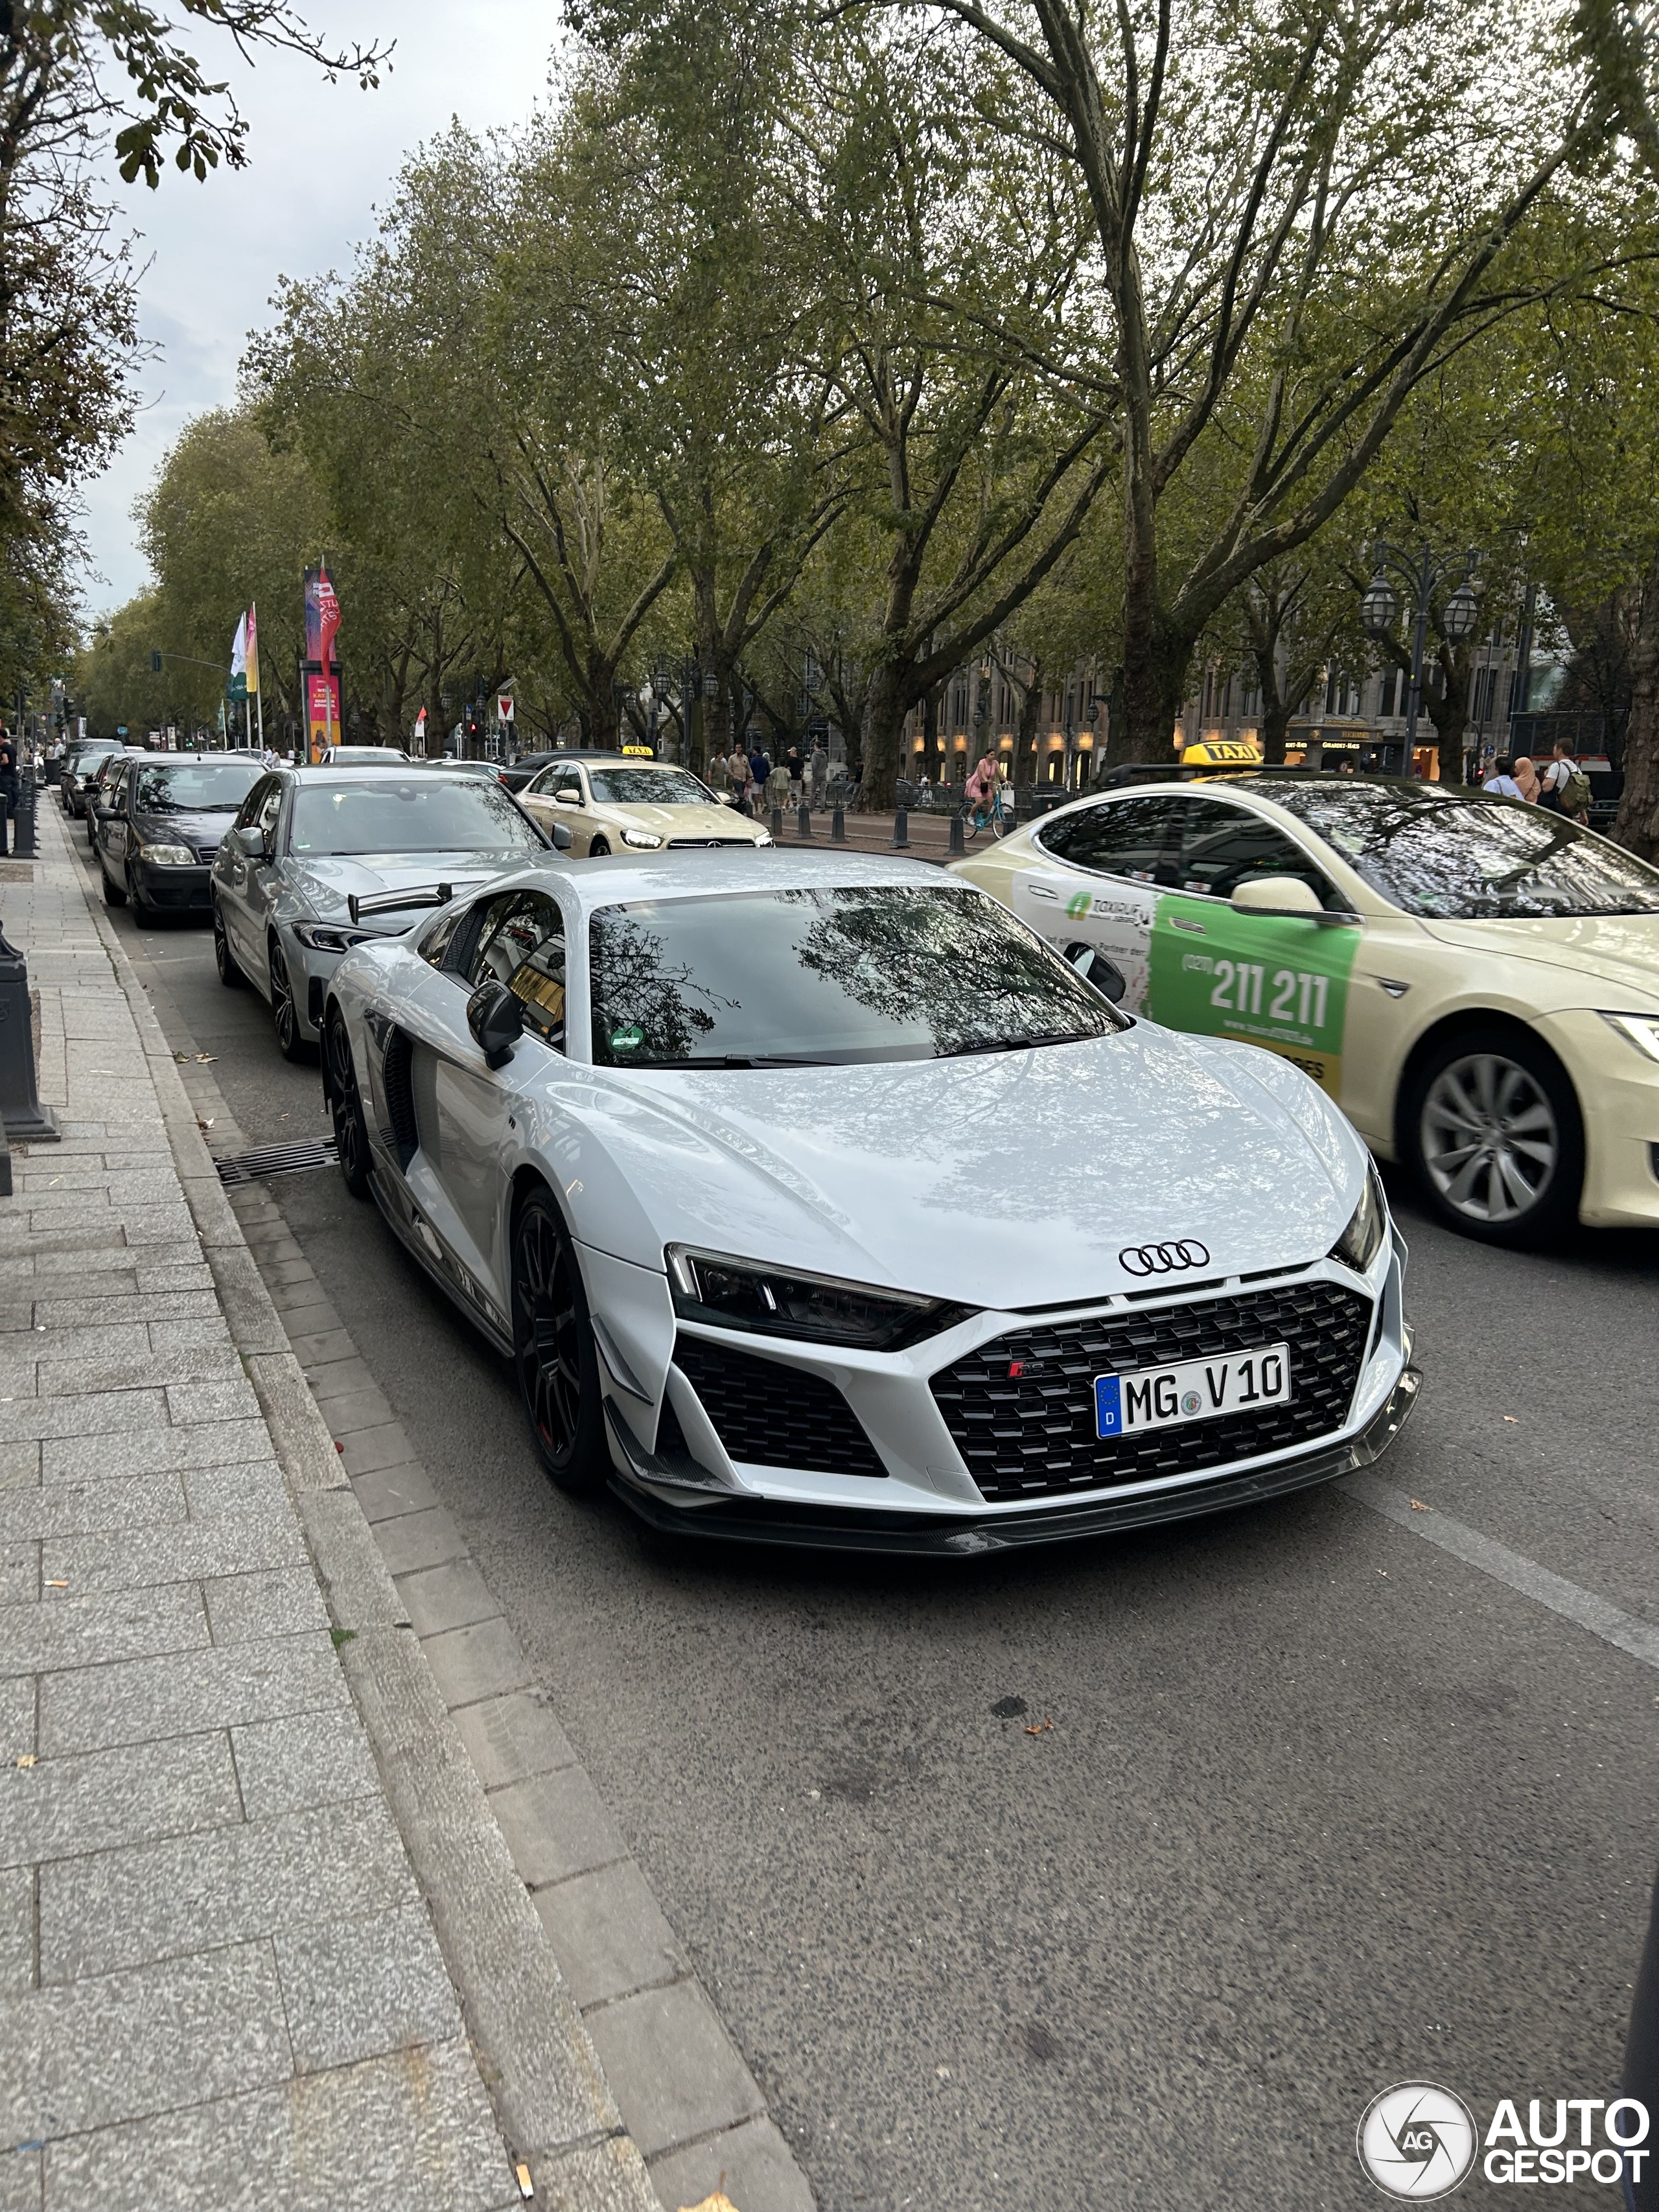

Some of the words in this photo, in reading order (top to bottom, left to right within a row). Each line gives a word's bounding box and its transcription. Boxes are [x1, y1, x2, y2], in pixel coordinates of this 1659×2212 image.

[1207, 745, 1254, 759] TAXI
[1211, 960, 1264, 1014] 211
[1269, 970, 1328, 1028] 211
[1126, 1374, 1179, 1425] MG
[1106, 1412, 1115, 1425] D
